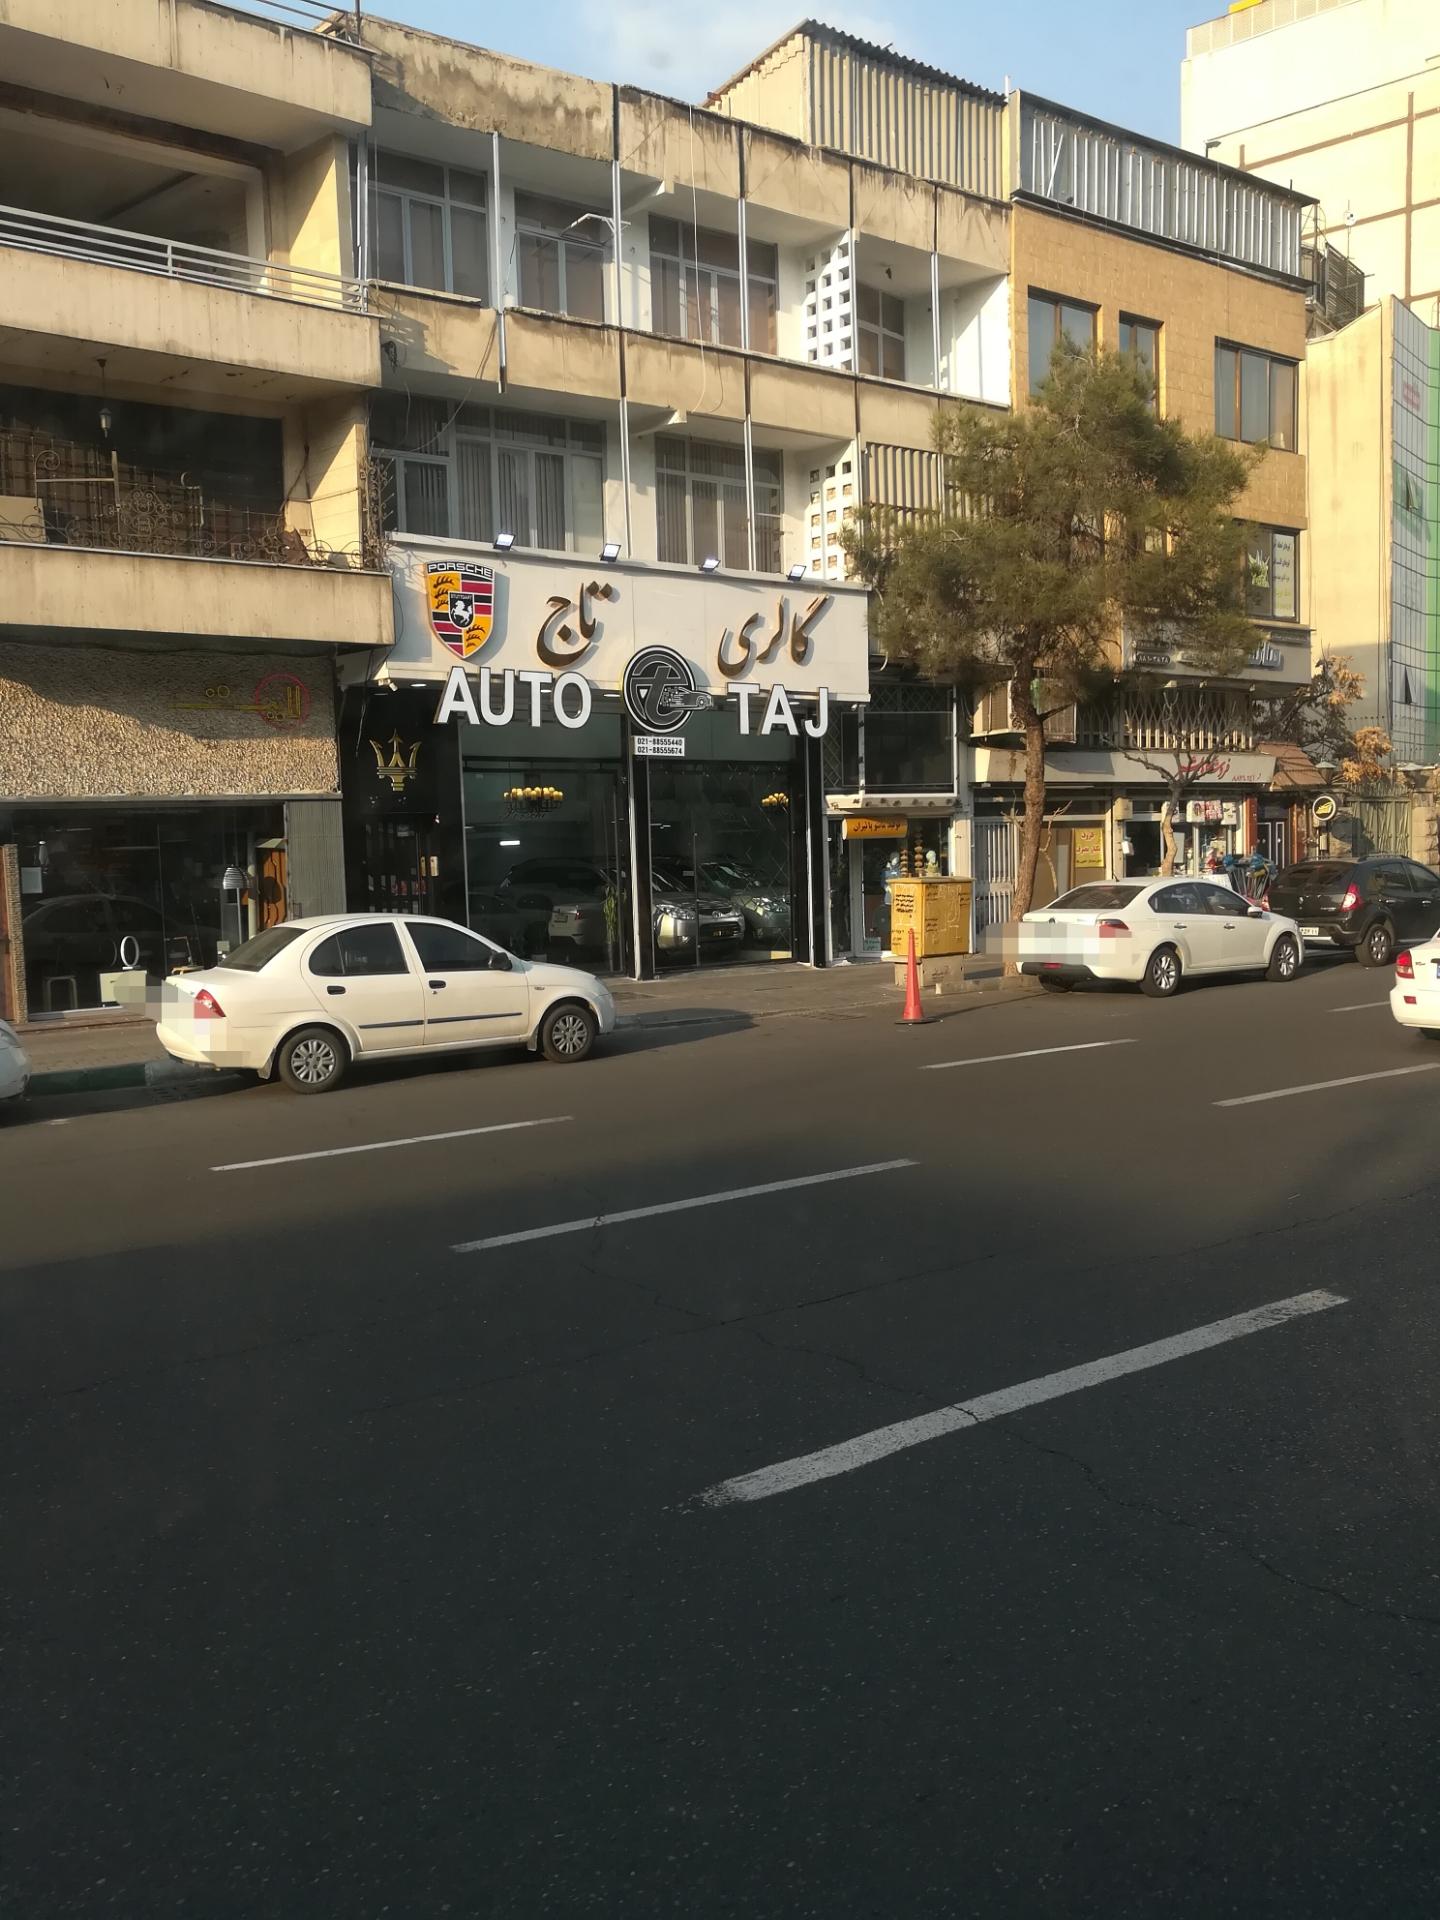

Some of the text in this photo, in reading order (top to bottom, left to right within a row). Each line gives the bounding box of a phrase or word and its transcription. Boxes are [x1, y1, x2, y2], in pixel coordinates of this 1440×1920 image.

[428, 562, 493, 577] PORSCHE
[536, 580, 830, 677] گالری تاج
[434, 665, 830, 739] AUTO TAJ
